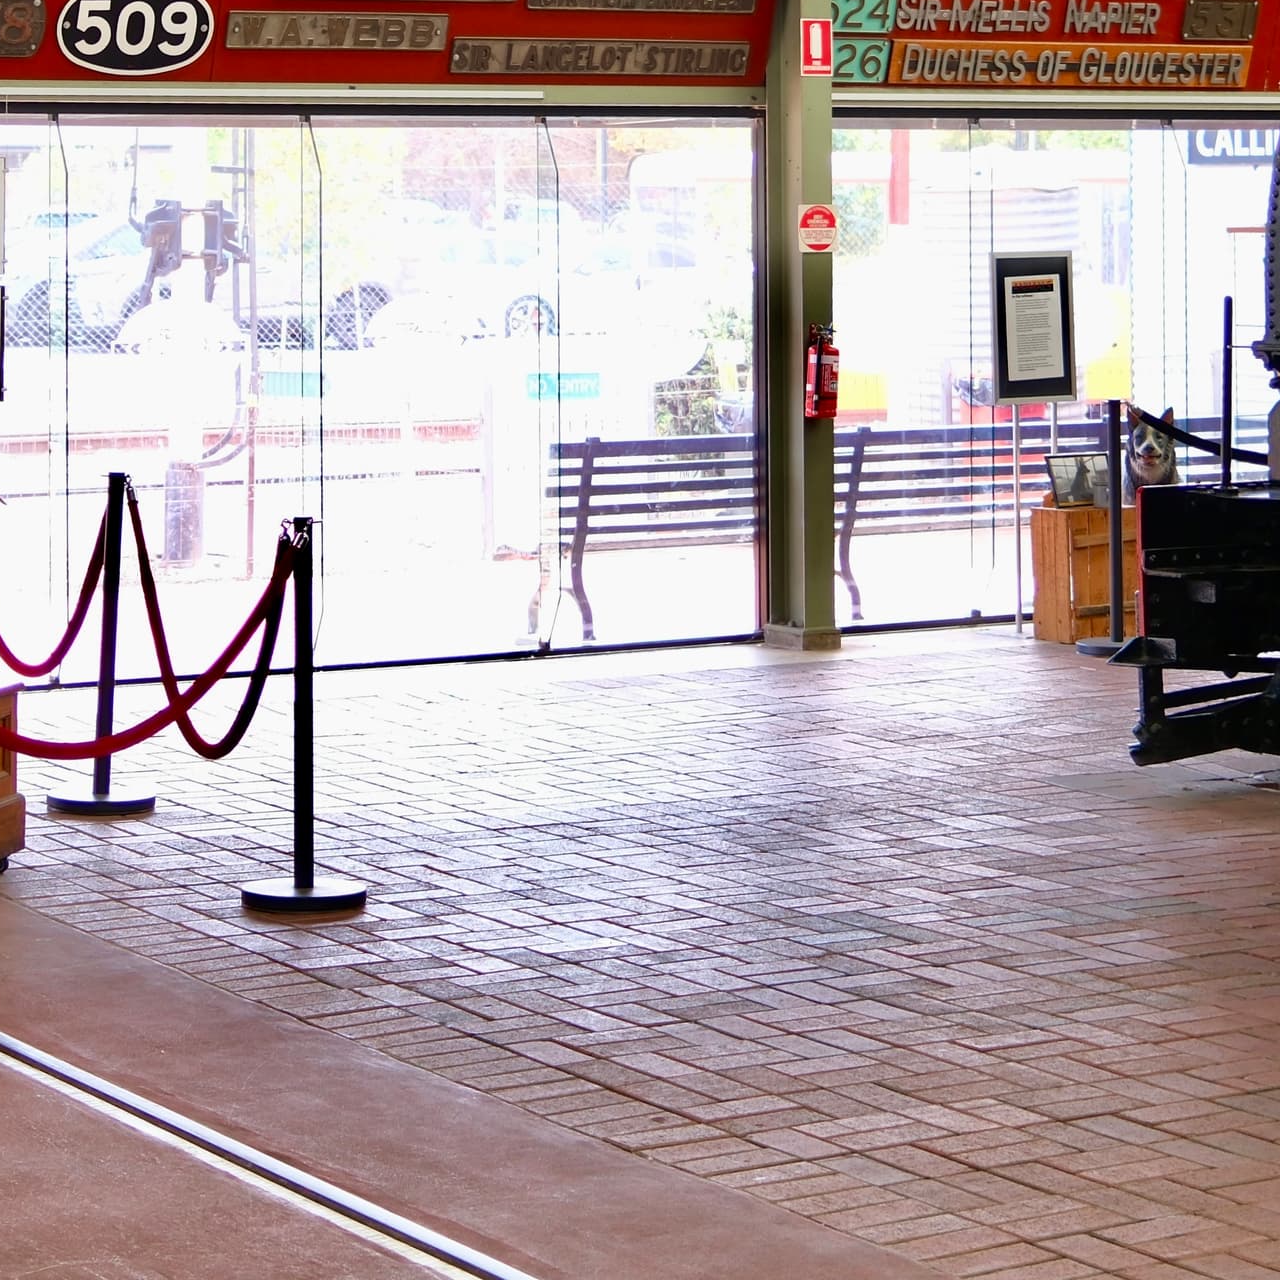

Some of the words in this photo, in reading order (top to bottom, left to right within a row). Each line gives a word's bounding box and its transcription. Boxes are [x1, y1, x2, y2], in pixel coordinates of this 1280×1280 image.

[326, 17, 435, 48] WEBB
[1191, 1, 1250, 40] 531
[453, 42, 491, 70] SIR
[902, 43, 1028, 83] DUCHESS
[1036, 49, 1072, 83] OF
[1078, 47, 1245, 86] GLOUCESTER
[1195, 130, 1280, 157] CALLI
